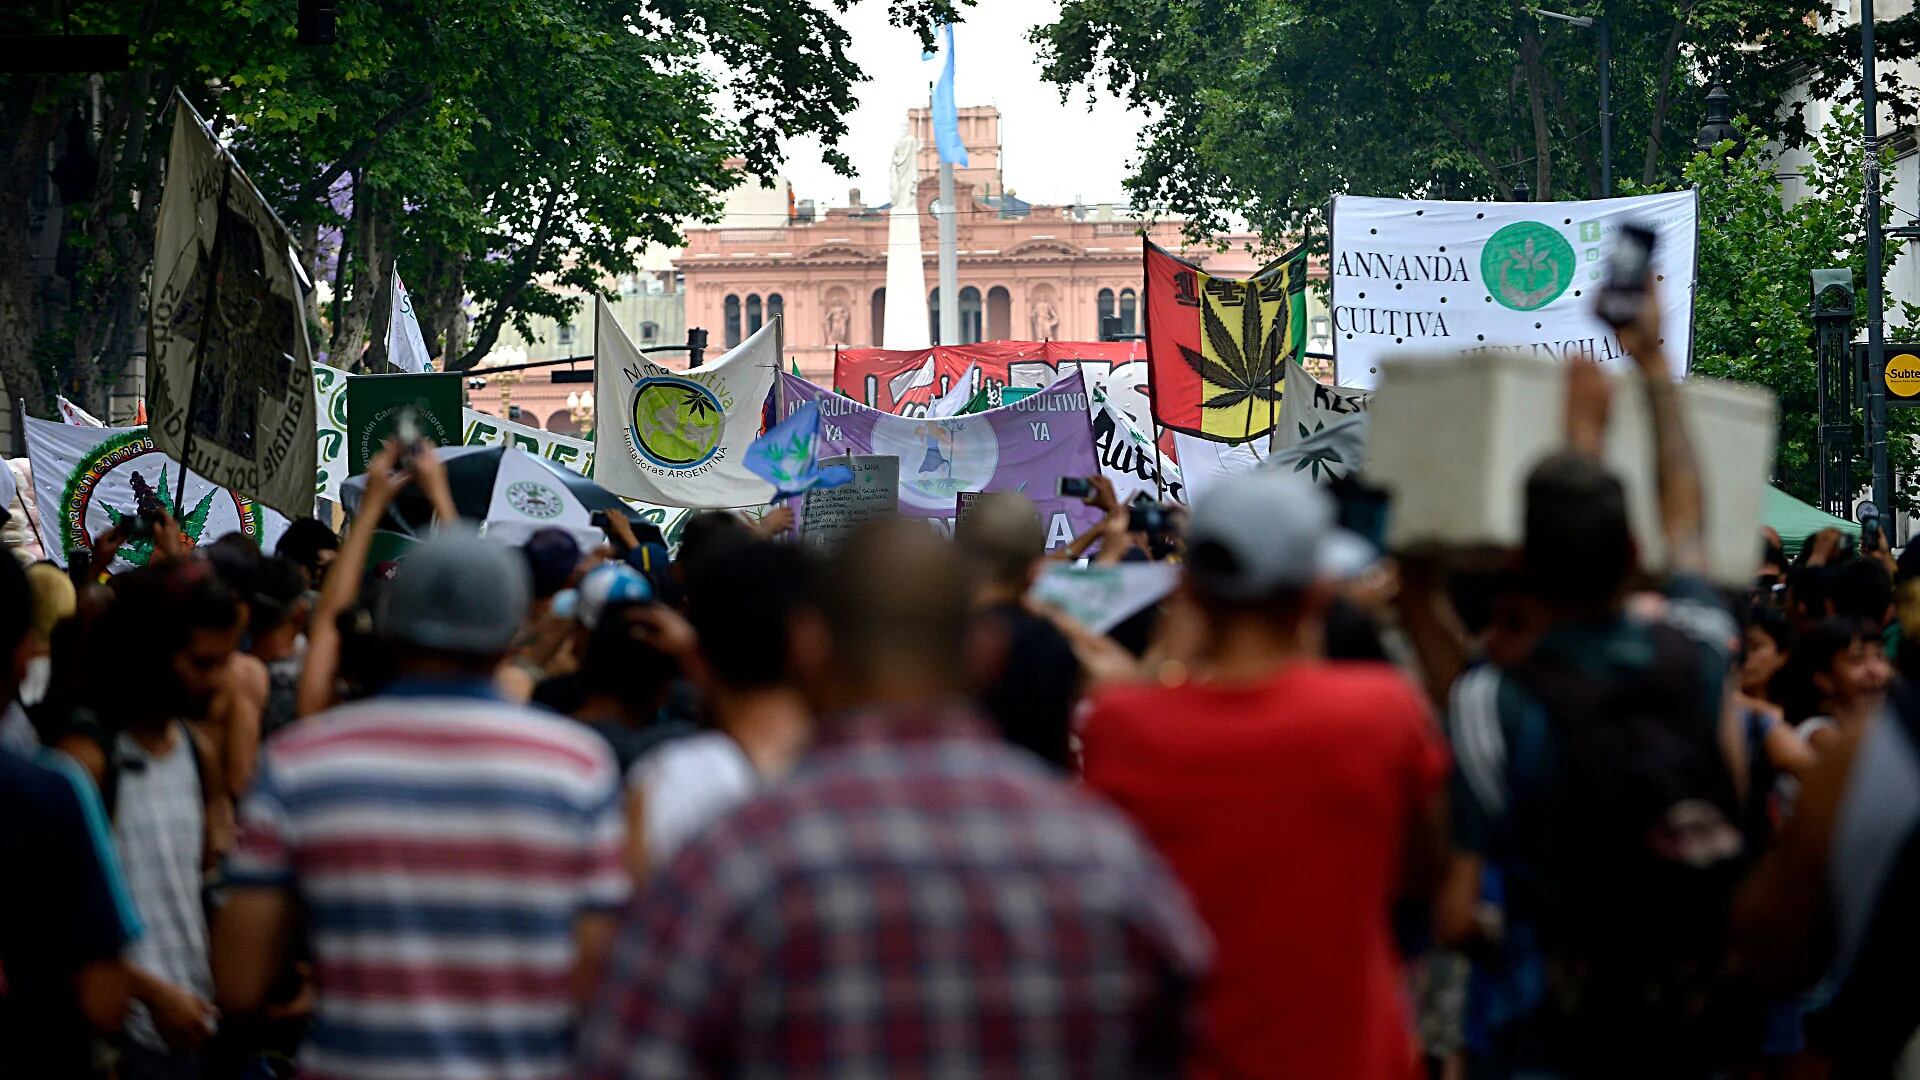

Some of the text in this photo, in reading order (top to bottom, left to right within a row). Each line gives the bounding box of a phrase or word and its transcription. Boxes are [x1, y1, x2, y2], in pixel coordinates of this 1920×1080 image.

[1335, 250, 1471, 283] ANNANDA
[1334, 305, 1450, 338] CULTIVA
[1890, 368, 1920, 379] Subte
[679, 373, 734, 410] ultiva
[1008, 392, 1087, 412] OCULTIVO
[360, 419, 377, 469] rupación
[824, 424, 843, 441] YA
[1030, 422, 1050, 441] YA
[94, 436, 155, 473] cannab
[624, 427, 665, 476] Fundadoras
[668, 446, 728, 479] ARGENTINA
